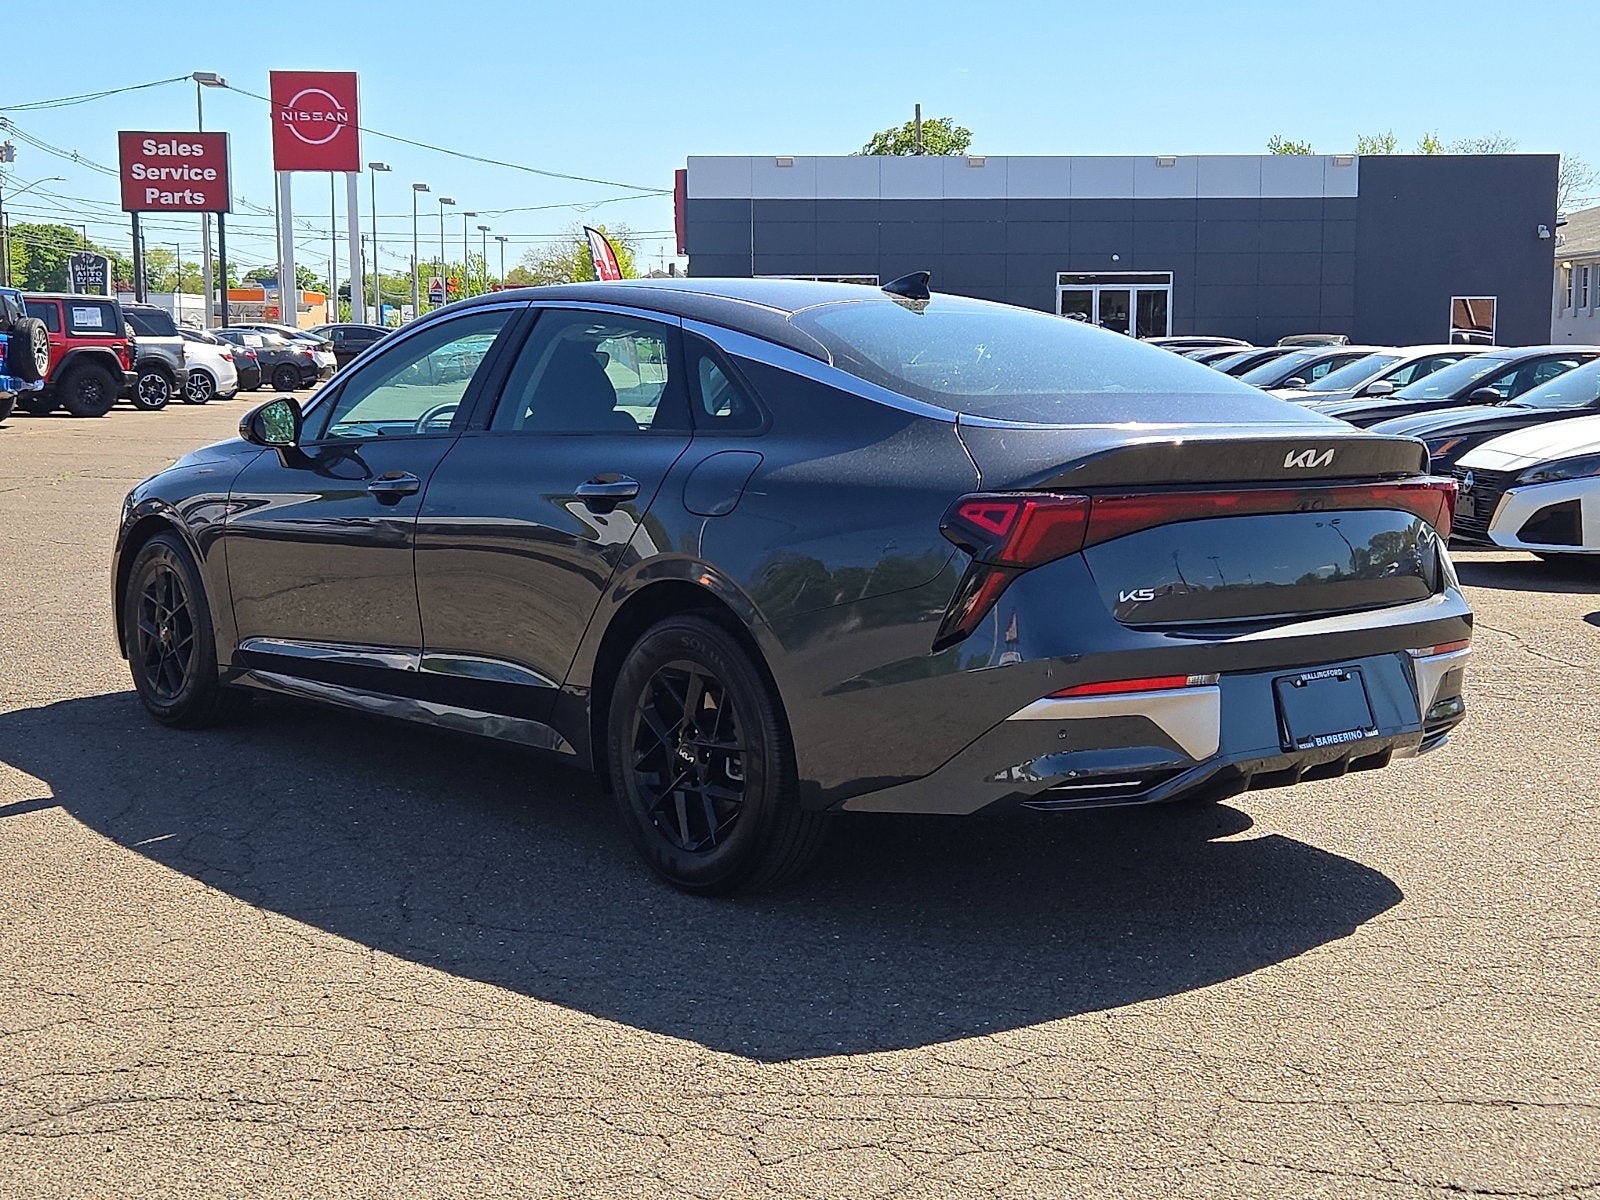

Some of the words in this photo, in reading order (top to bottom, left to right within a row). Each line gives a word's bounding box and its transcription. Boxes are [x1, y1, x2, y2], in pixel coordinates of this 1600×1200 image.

[281, 111, 348, 122] NISSAN
[142, 139, 204, 156] Sales
[131, 163, 217, 180] Service
[145, 188, 206, 204] Parts
[1119, 588, 1155, 603] K5
[1300, 668, 1343, 681] WALLINGFORD
[1315, 730, 1363, 747] BARBERINO
